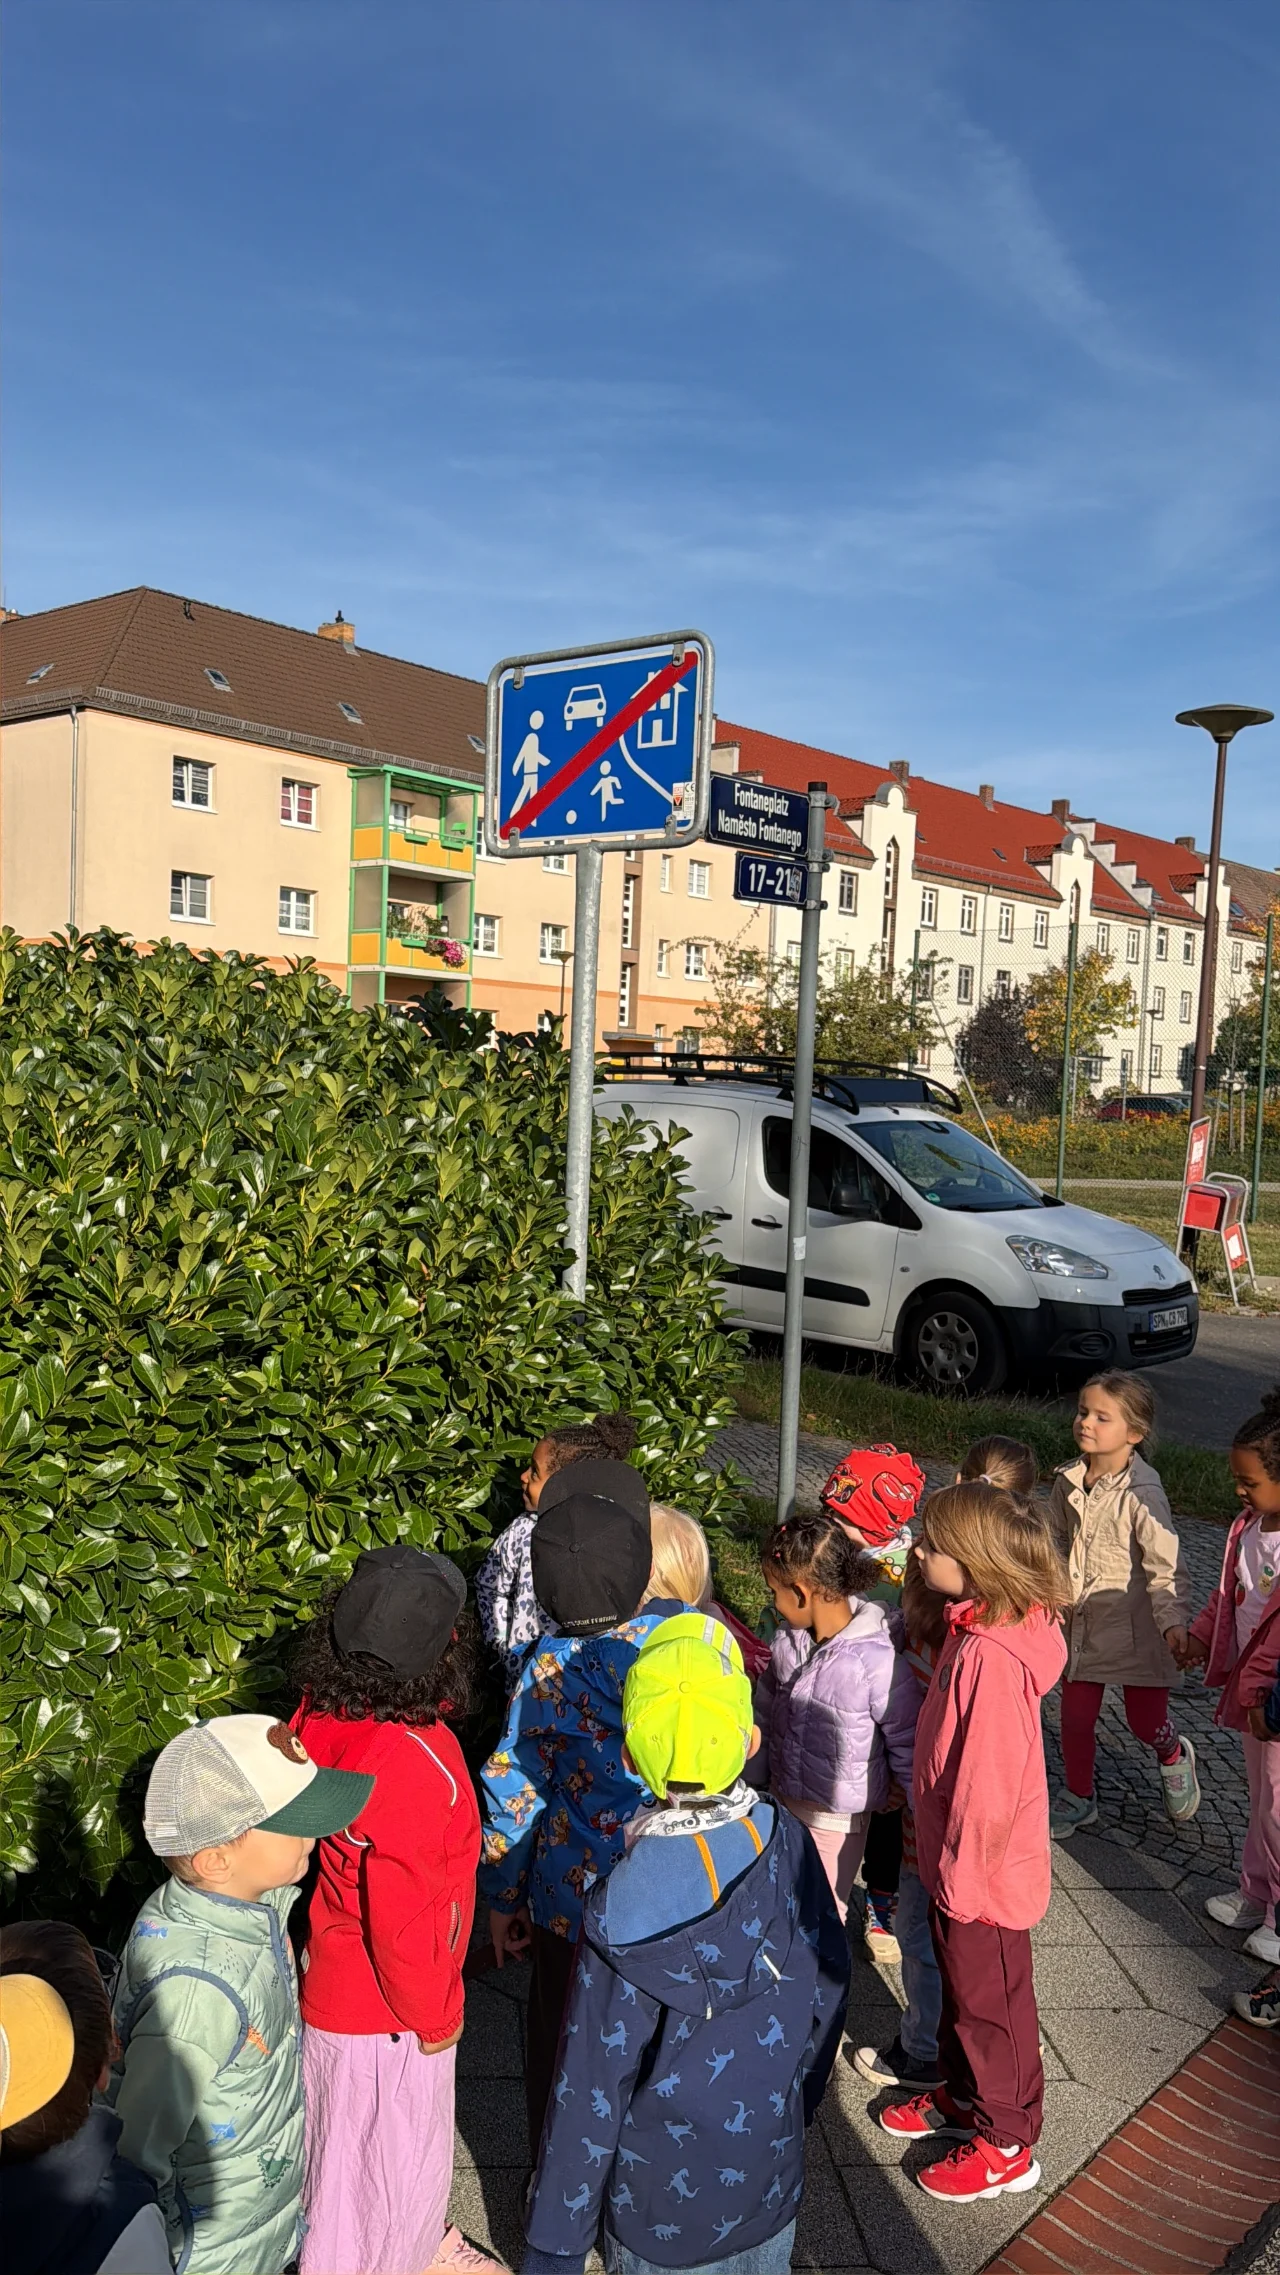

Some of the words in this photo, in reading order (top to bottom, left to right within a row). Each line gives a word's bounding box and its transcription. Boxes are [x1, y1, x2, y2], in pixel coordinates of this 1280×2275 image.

[734, 783, 789, 818] Fontaneplatz
[718, 809, 757, 839] Naměsto
[759, 818, 802, 852] Fontanego
